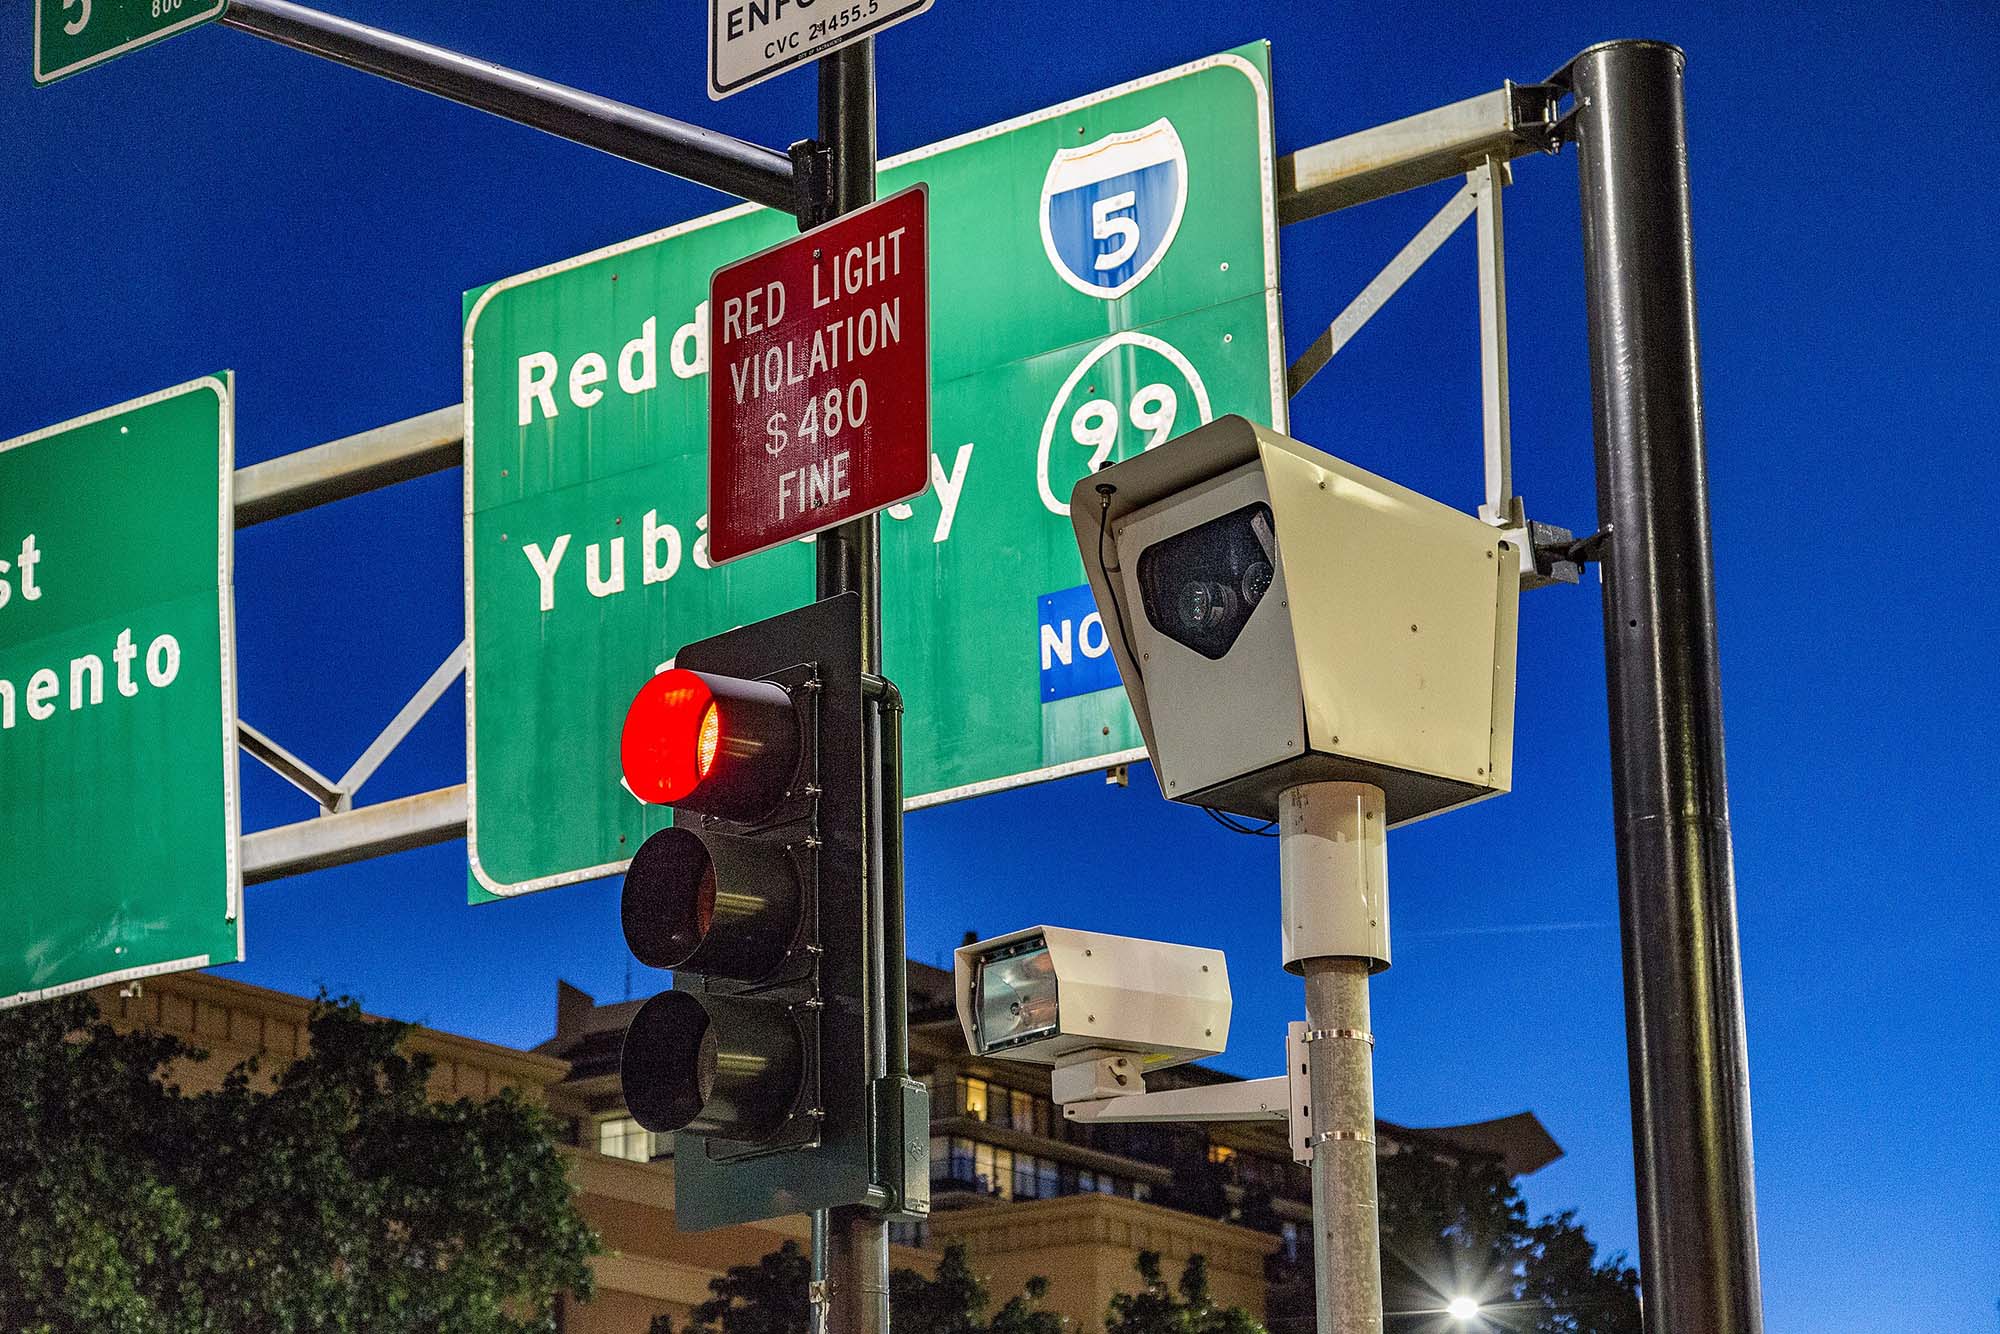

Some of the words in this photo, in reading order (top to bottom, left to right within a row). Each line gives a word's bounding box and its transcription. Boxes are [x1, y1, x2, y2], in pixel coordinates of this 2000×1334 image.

[727, 0, 815, 42] ENF
[764, 31, 800, 59] CVC
[808, 0, 878, 41] 21455.5
[1091, 190, 1140, 270] 5
[723, 280, 786, 345] RED
[812, 226, 906, 309] LIGHT
[730, 296, 900, 404] VIOLATION
[1070, 383, 1178, 474] 99
[778, 449, 851, 520] FINE
[1040, 611, 1111, 671] NO
